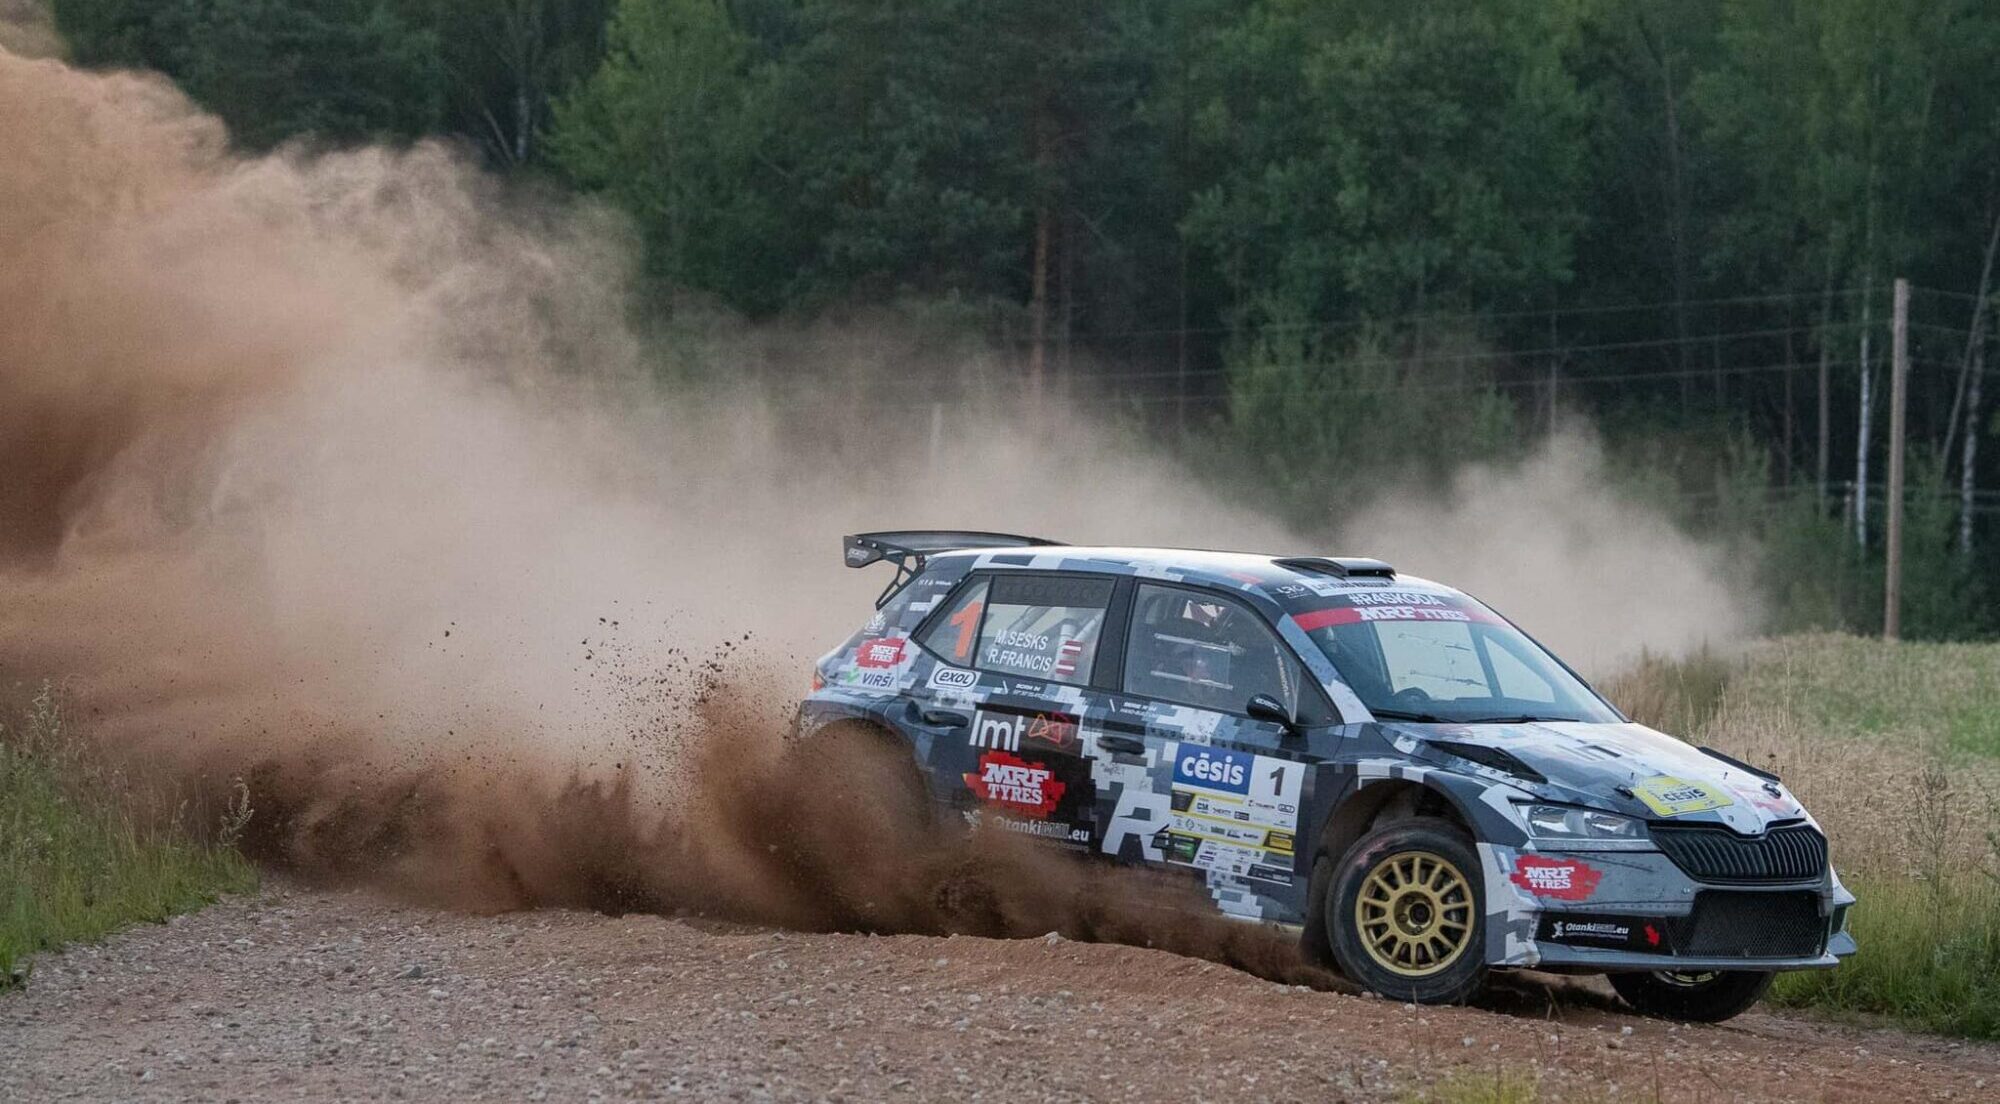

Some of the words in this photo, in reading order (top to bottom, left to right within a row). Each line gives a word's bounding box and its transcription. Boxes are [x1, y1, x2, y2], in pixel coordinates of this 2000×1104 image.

[1353, 607, 1416, 621] MRF
[951, 600, 982, 658] 1
[994, 629, 1049, 650] M.SESKS
[987, 648, 1052, 672] R.FRANCIS
[969, 710, 1026, 752] lmt
[982, 763, 1050, 788] MRF
[1181, 752, 1244, 786] cēsis
[1269, 766, 1286, 796] 1
[988, 783, 1043, 805] TYRES
[1524, 866, 1575, 879] MRF
[1529, 878, 1571, 890] TYRES
